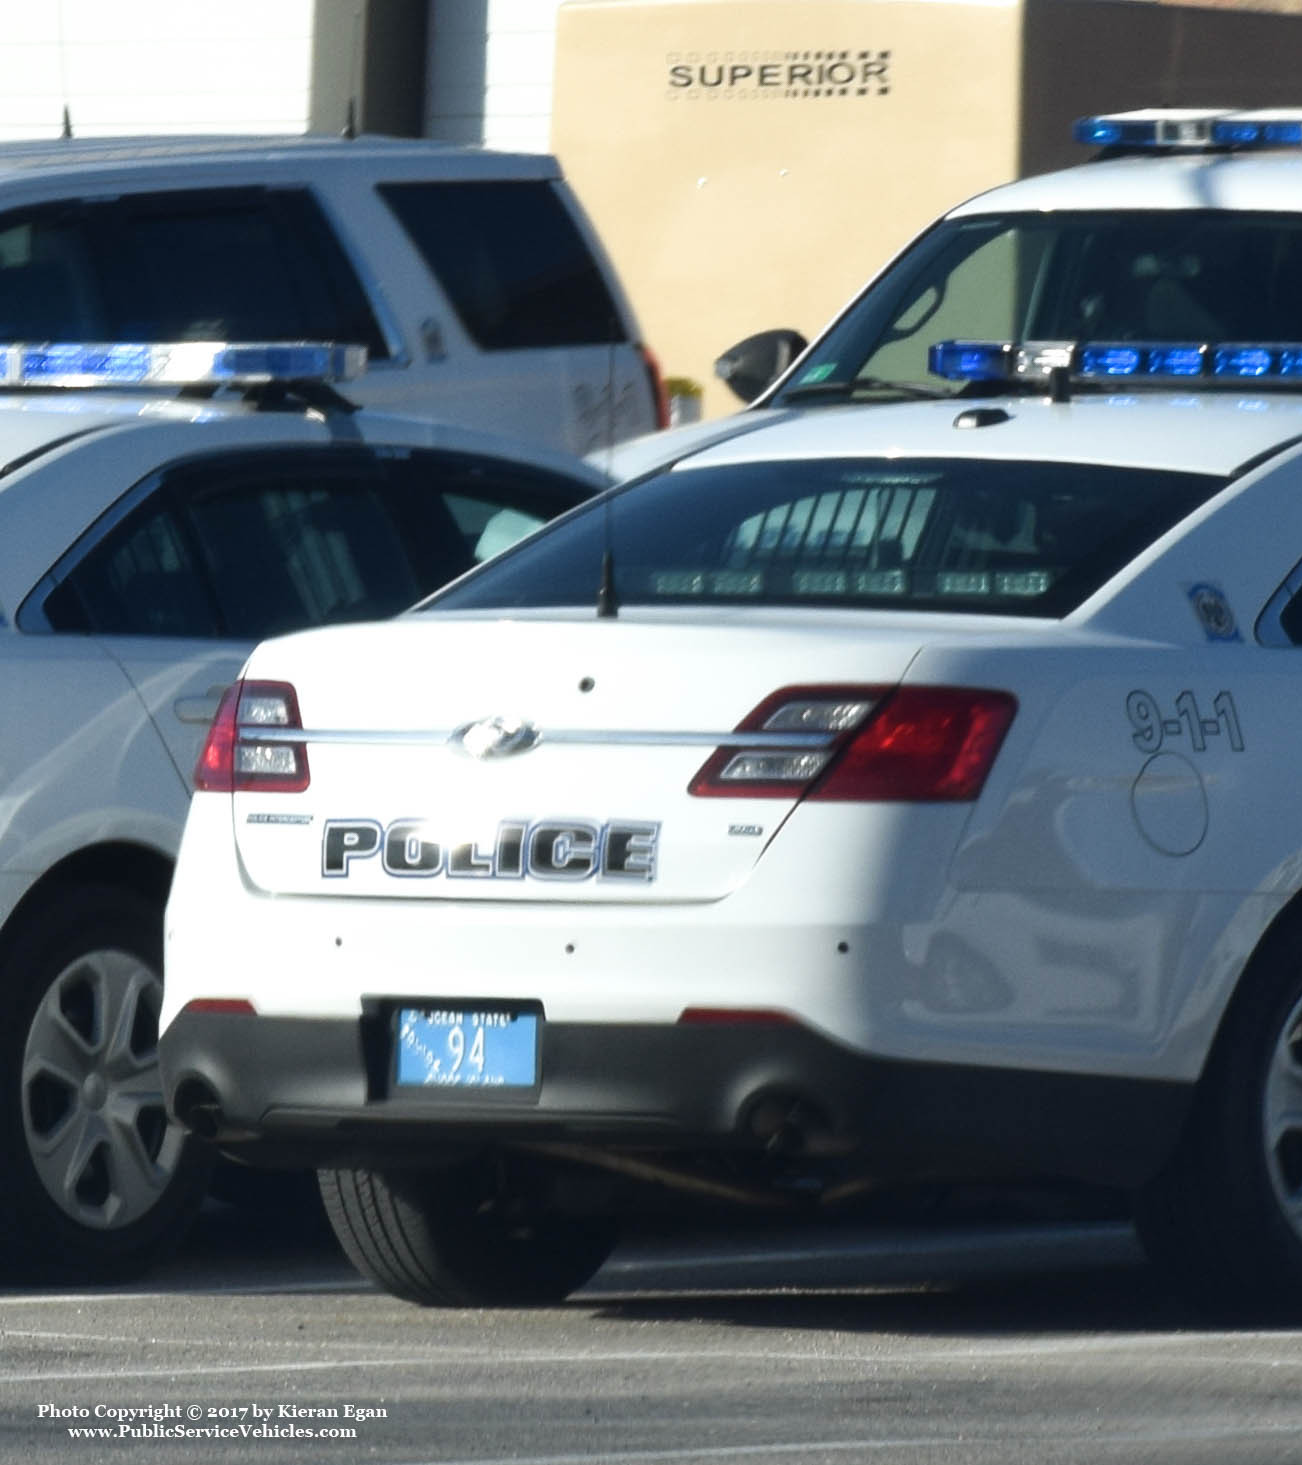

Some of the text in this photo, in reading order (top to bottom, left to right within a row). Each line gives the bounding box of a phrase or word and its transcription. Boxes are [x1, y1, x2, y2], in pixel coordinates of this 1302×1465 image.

[668, 62, 889, 87] SUPERIOR
[1126, 688, 1245, 754] 9-1-1
[321, 818, 662, 884] POLICE
[447, 1024, 486, 1074] 94
